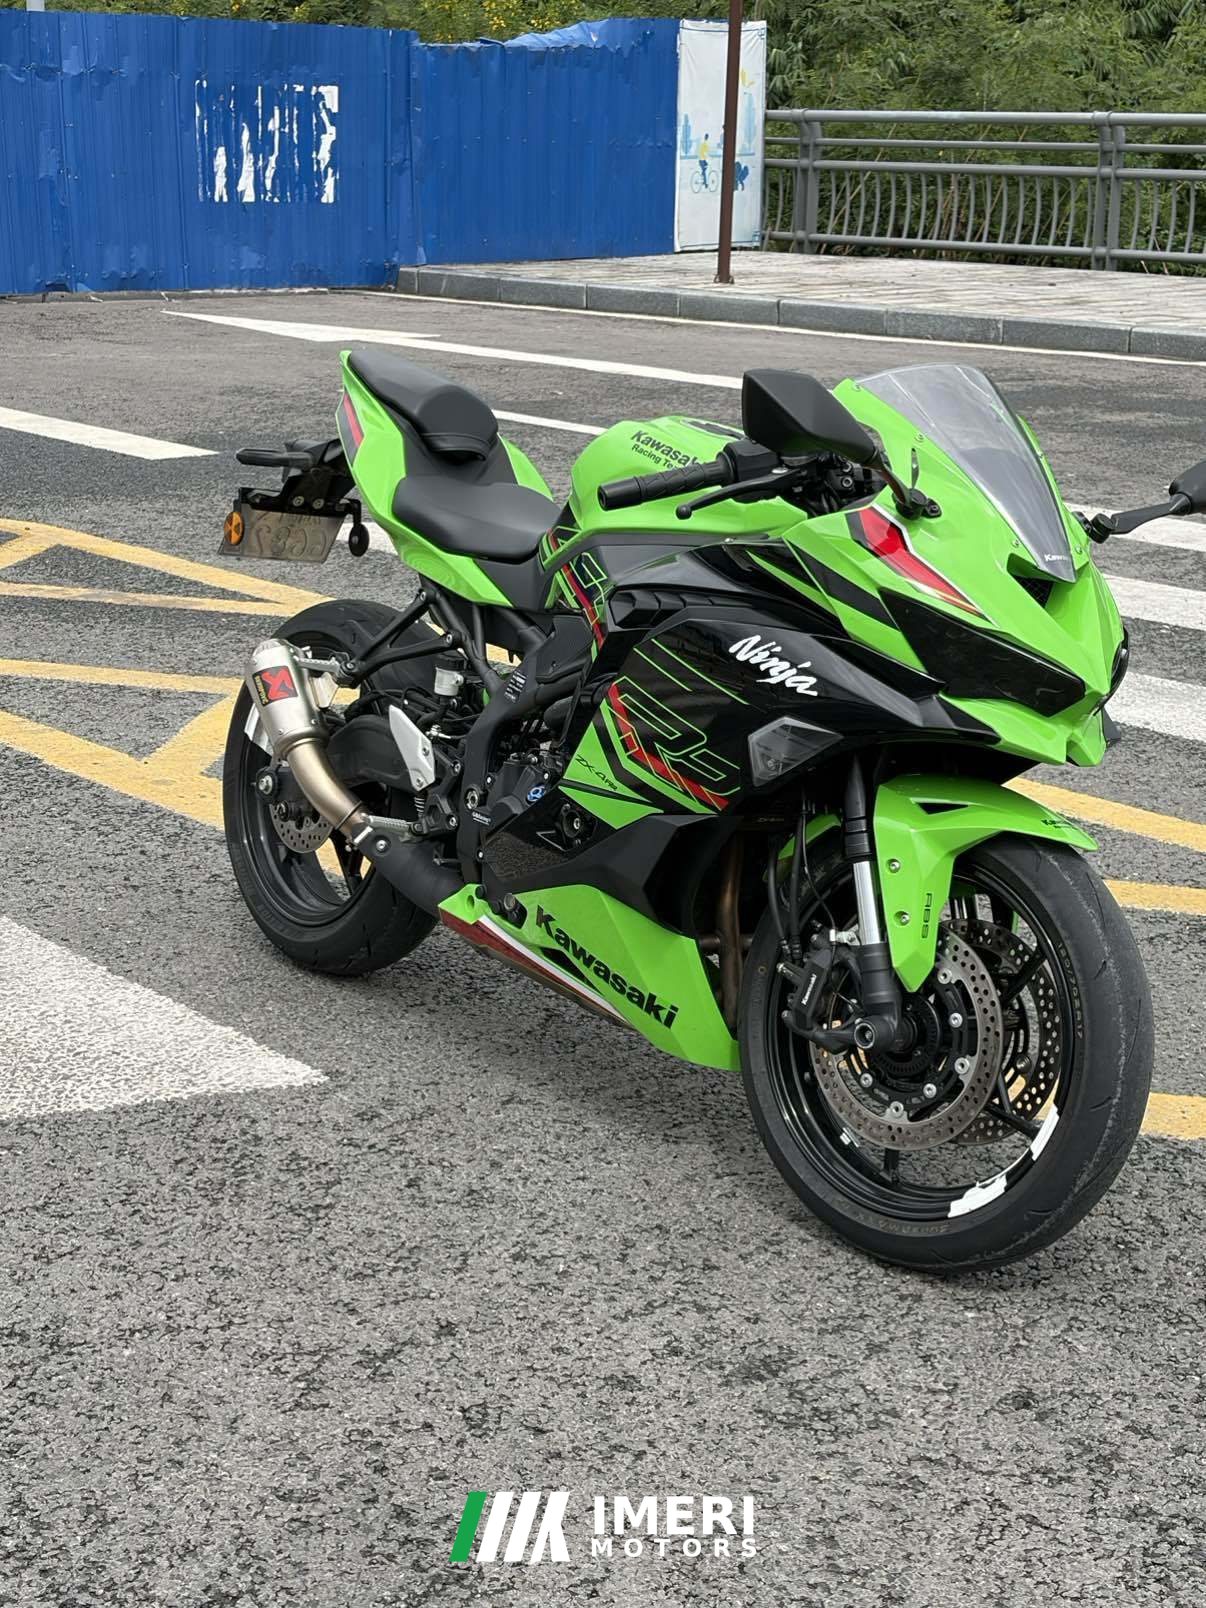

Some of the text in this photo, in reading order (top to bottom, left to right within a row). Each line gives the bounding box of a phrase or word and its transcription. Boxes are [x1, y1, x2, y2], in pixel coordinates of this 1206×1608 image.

[631, 443, 662, 464] Racing
[728, 634, 818, 697] Ninja
[535, 904, 679, 1030] Kawasaki
